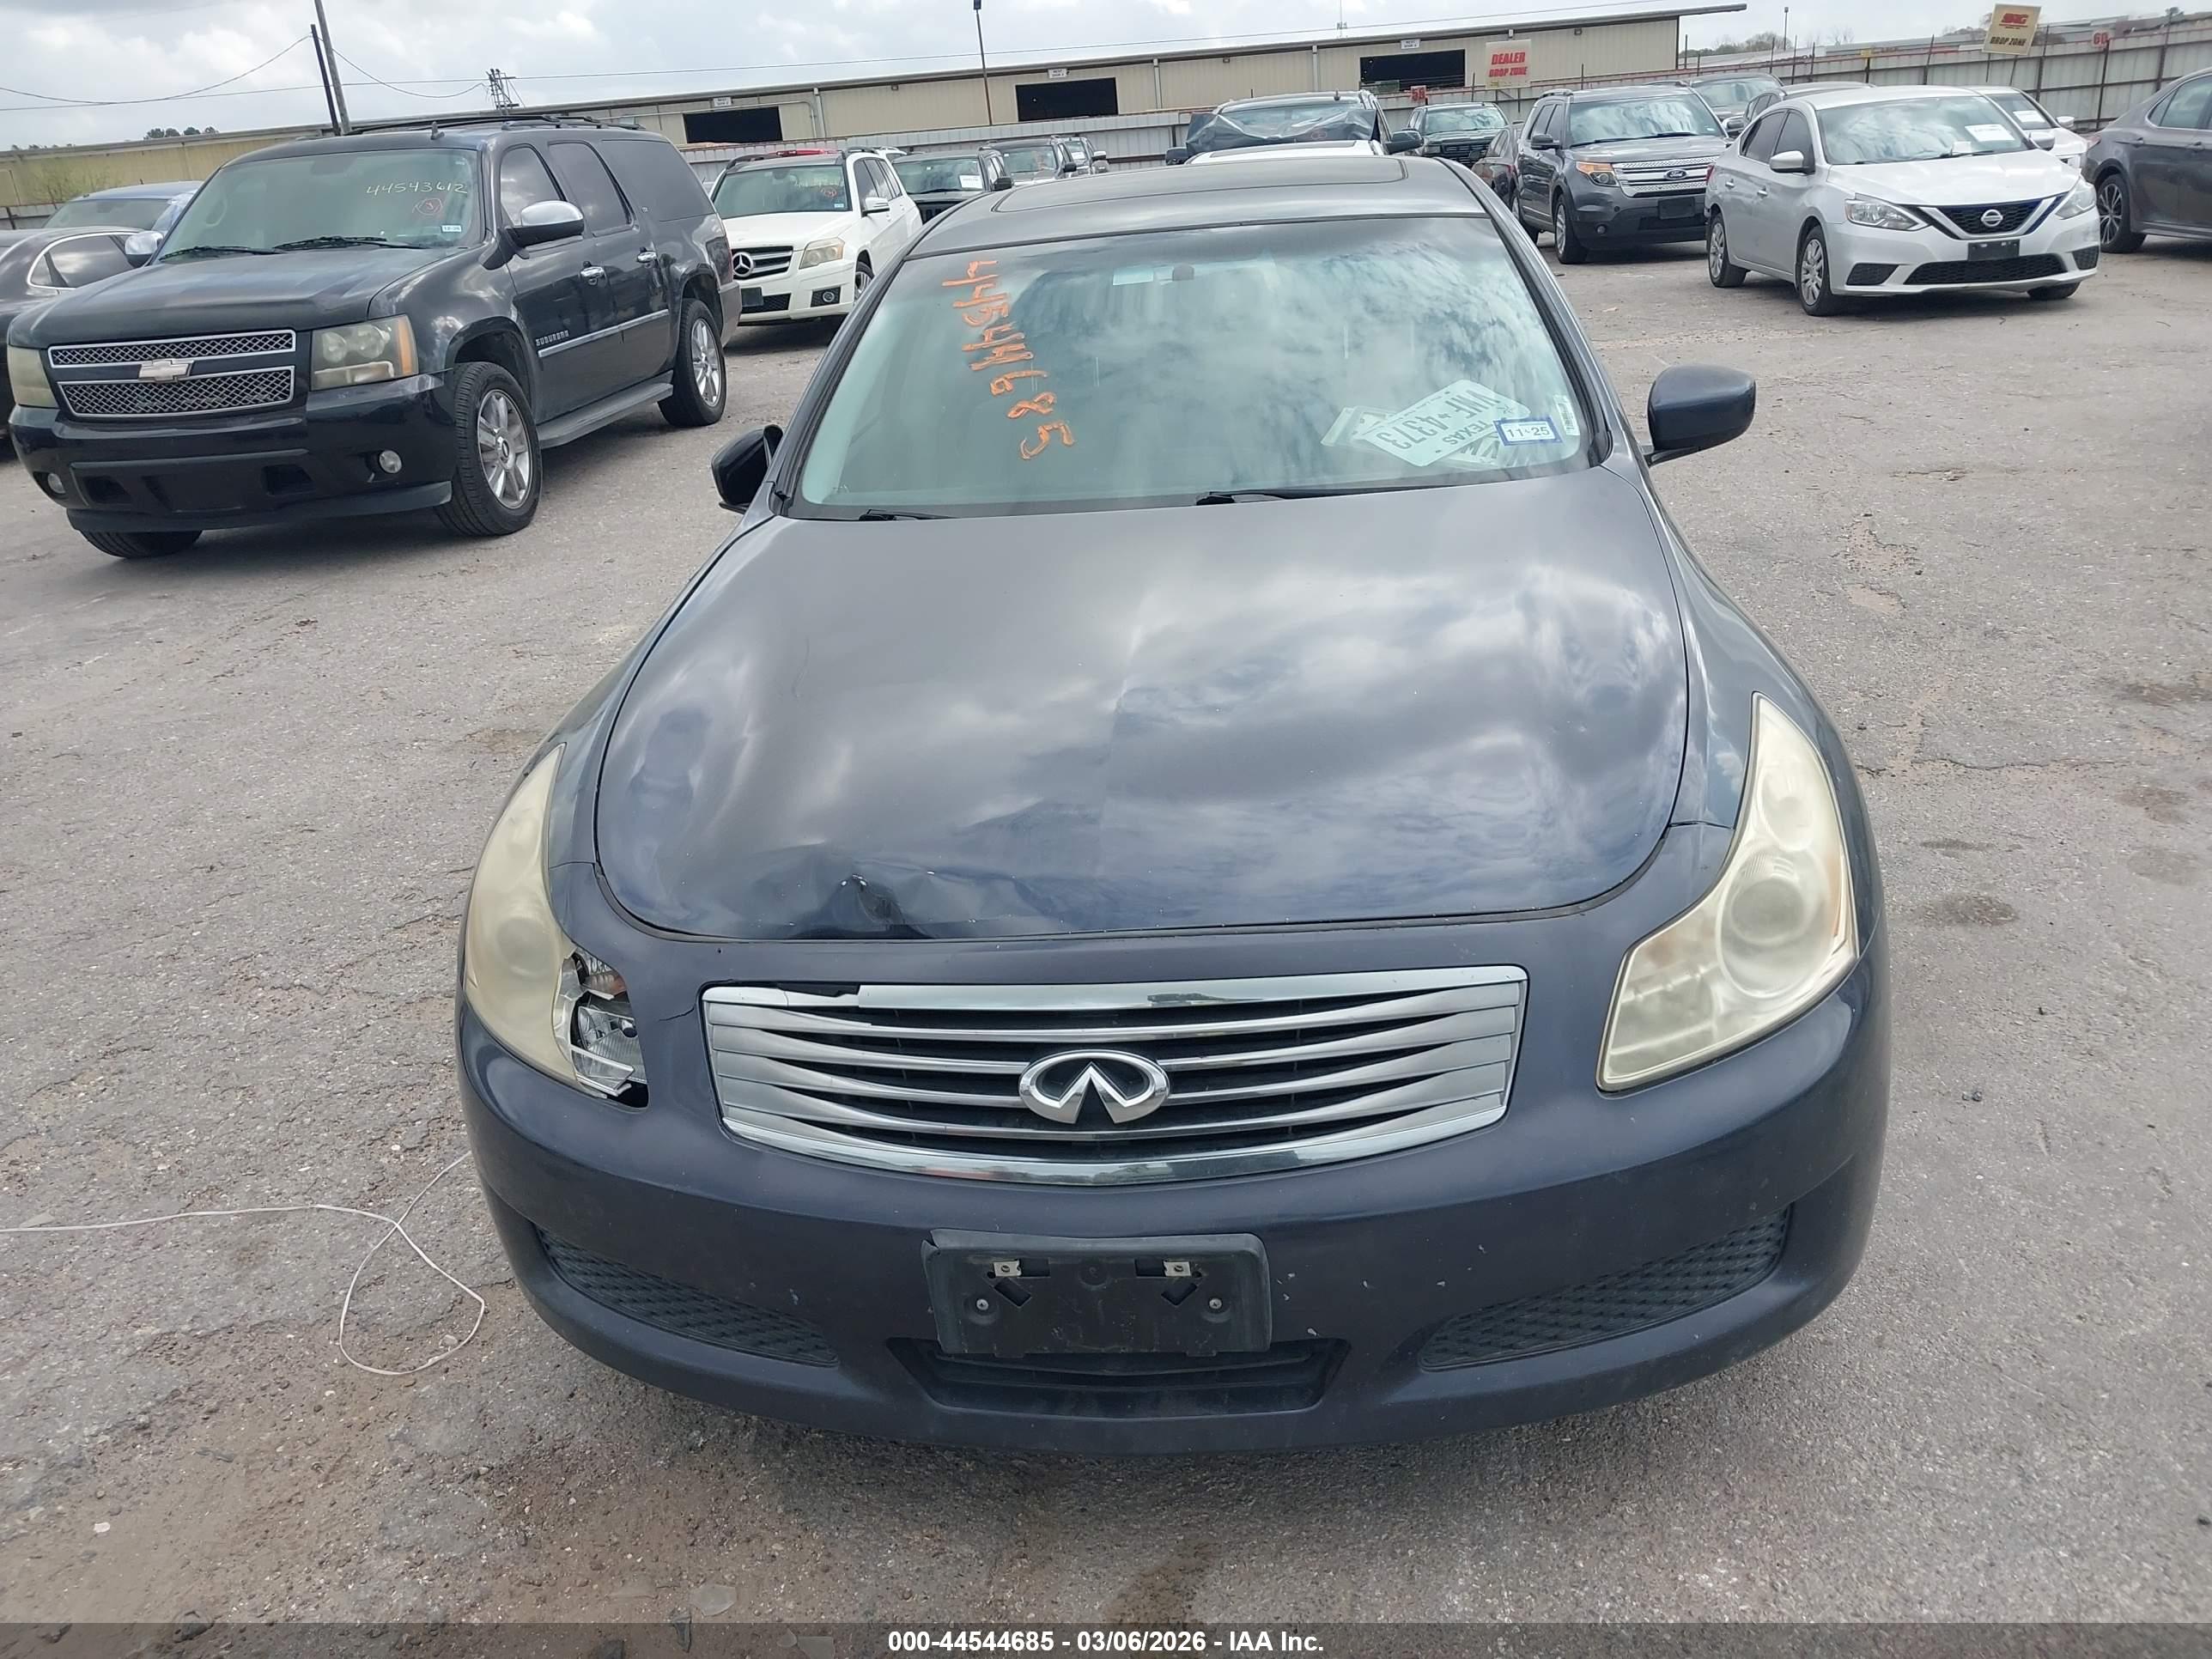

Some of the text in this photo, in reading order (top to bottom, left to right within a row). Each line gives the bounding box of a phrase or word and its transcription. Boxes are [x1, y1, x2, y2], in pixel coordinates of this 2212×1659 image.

[1492, 52, 1526, 64] DEALER
[1489, 67, 1528, 77] DROP ZONE
[366, 180, 468, 197] 44543612
[942, 260, 1074, 460] 44544685
[1442, 420, 1493, 445] TEXAS
